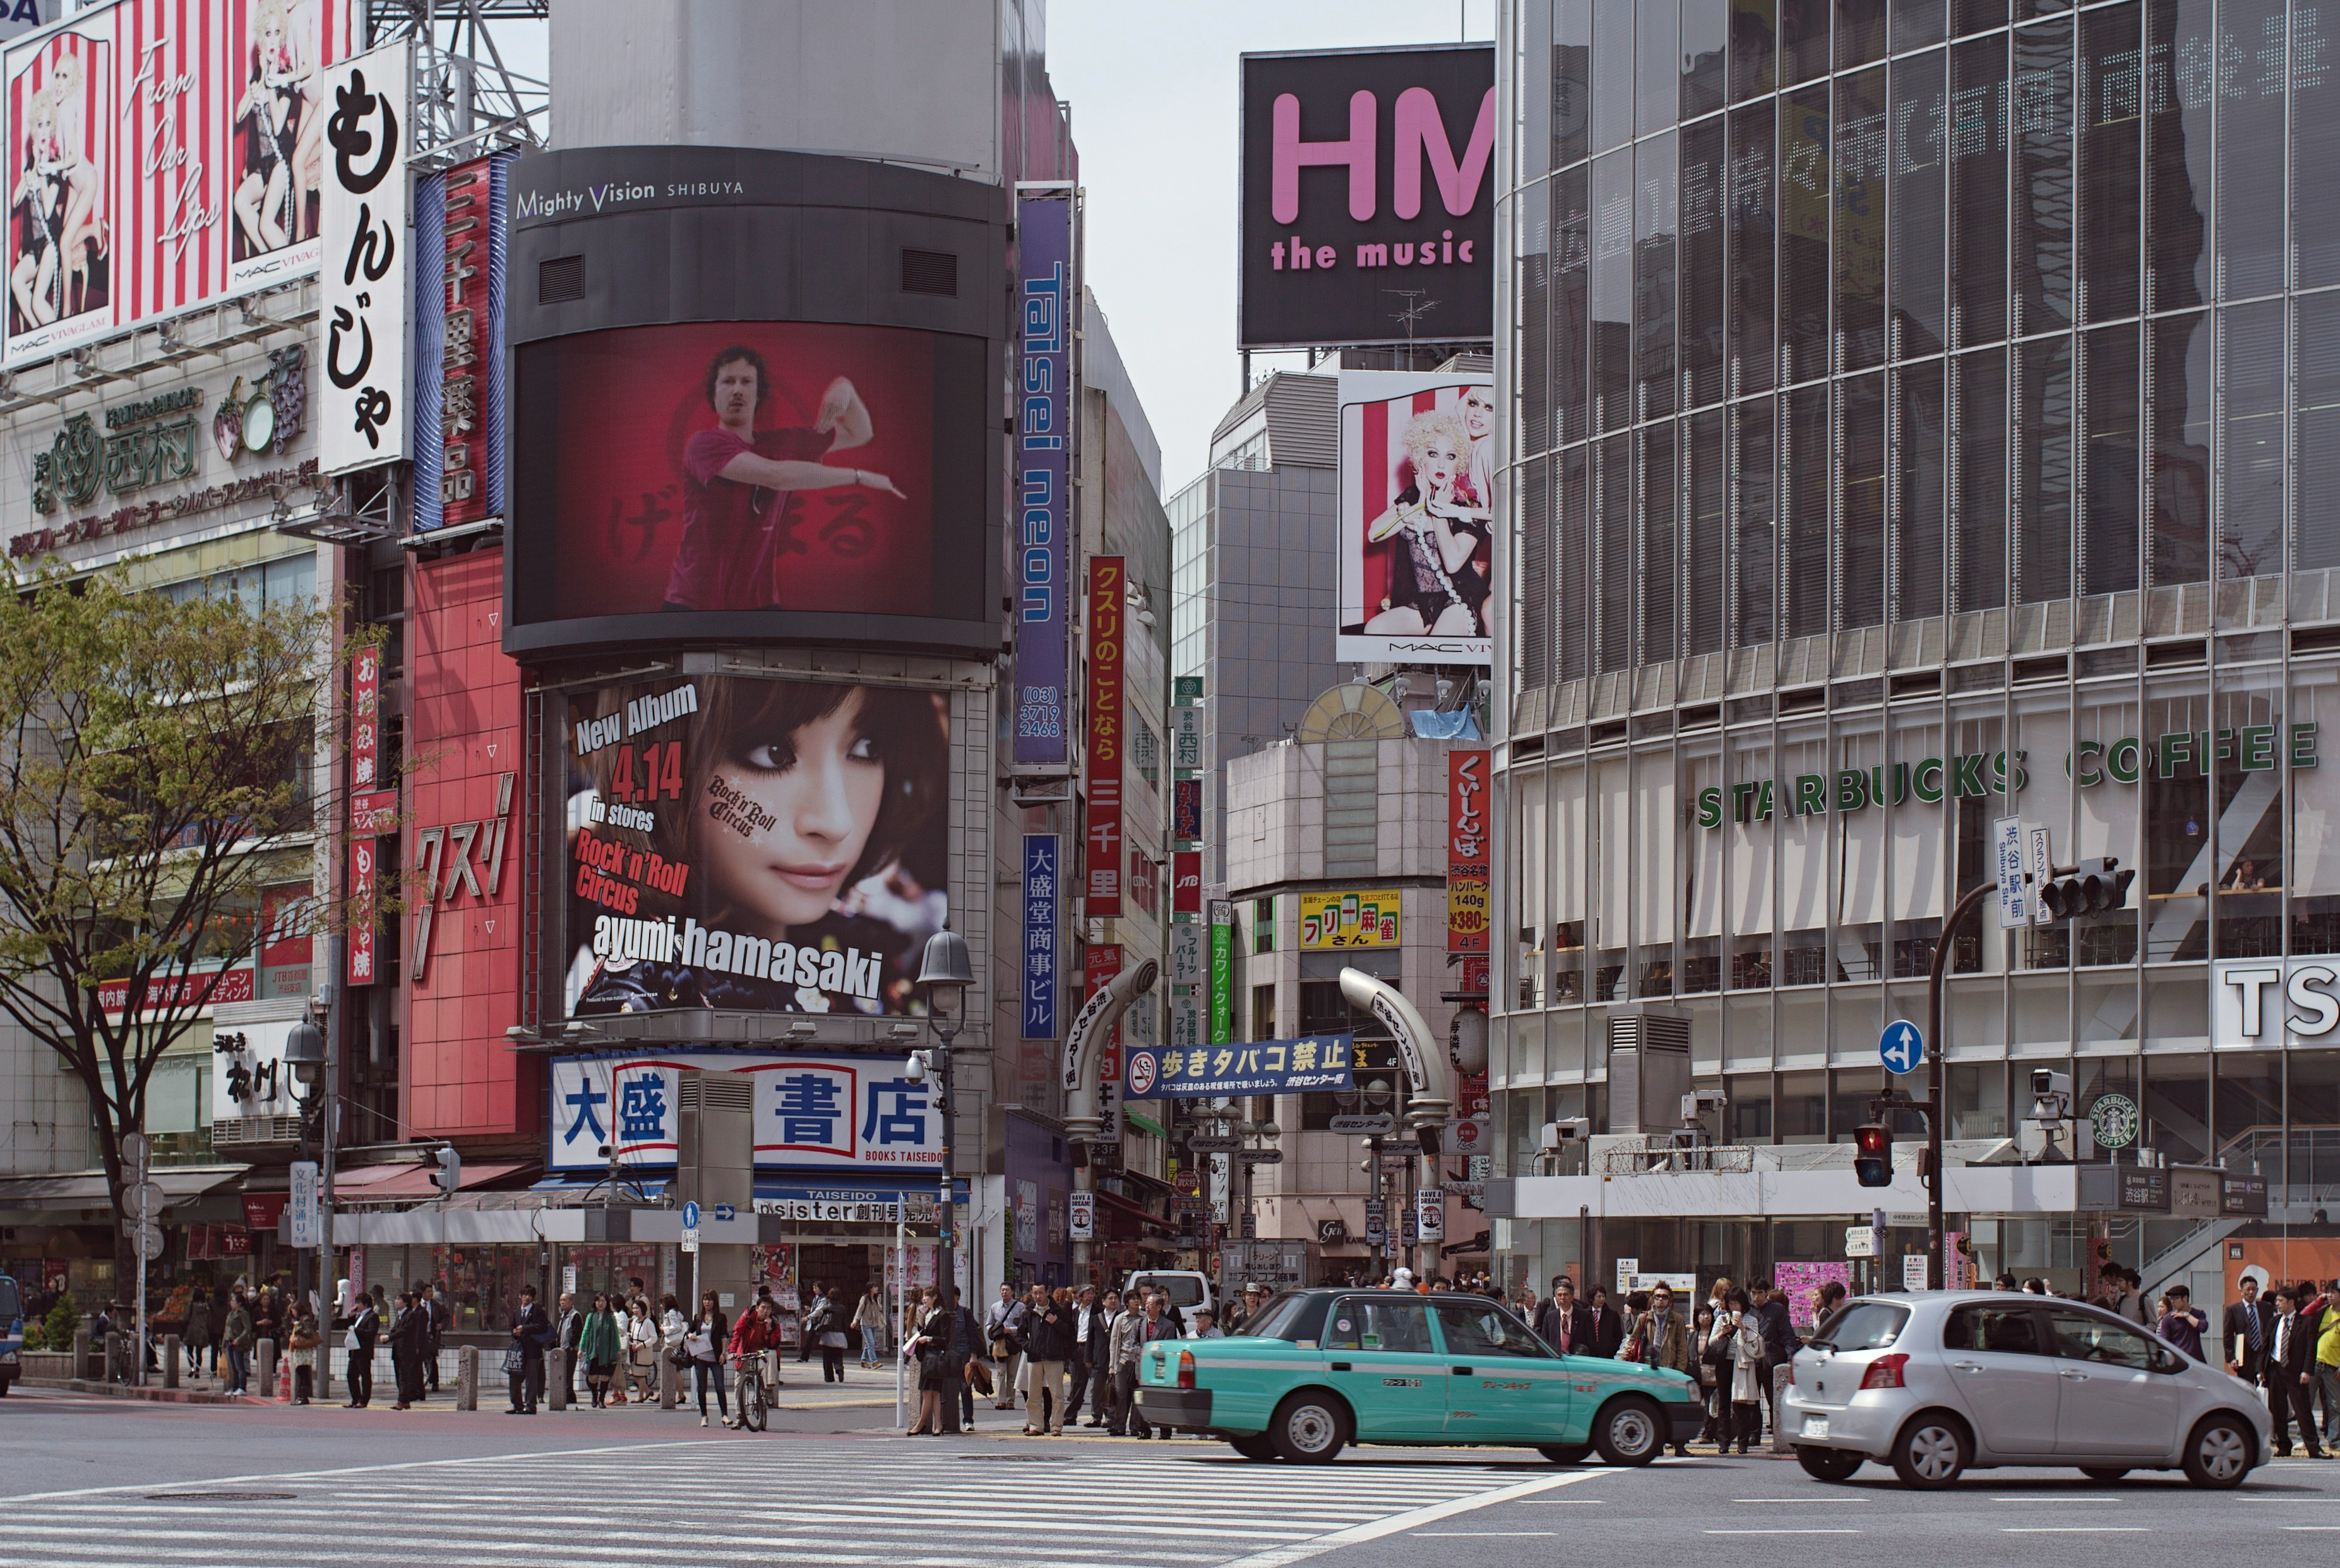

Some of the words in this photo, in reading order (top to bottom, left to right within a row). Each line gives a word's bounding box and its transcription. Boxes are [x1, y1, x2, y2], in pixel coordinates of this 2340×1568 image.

[123, 37, 195, 119] From
[143, 112, 188, 179] Our
[157, 162, 221, 263] Lips
[516, 189, 583, 218] Mighty
[589, 182, 654, 212] Vision
[668, 181, 744, 197] SHIBUYA
[327, 69, 399, 449] もんじゃ
[1271, 236, 1336, 270] the
[1357, 230, 1473, 268] music
[1023, 261, 1062, 451] Taisei
[105, 413, 198, 495] 西村
[1023, 468, 1052, 623] neon
[1094, 567, 1118, 761] クスリのことなら
[1020, 705, 1060, 721] 3719
[1023, 687, 1057, 704] (03)
[576, 711, 621, 756] New
[628, 682, 698, 738] Album
[1019, 722, 1060, 737] 2468
[1179, 733, 1198, 764] 西村
[611, 740, 683, 803] 4.14
[1697, 749, 2028, 829] STARBUCKS
[2065, 721, 2319, 788] COFFEE
[590, 796, 606, 822] in
[608, 804, 654, 833] stores
[1454, 756, 1484, 858] くいしんぼ
[1089, 780, 1120, 898] 三千里
[410, 772, 516, 981] クスリ
[575, 828, 689, 898] Rock'n'Roll
[1452, 864, 1488, 877] 渋谷名物
[1998, 842, 2007, 884] Shibuya
[2006, 826, 2023, 918] 渋谷駅前
[575, 863, 639, 915] Circus
[1450, 881, 1488, 892] ハンバーグ
[1455, 895, 1484, 908] 140g
[1028, 849, 1053, 1025] 大盛堂商事ビル
[1304, 908, 1394, 943] フリー麻雀
[1332, 935, 1369, 946] さん
[1459, 936, 1480, 949] 4F
[593, 913, 676, 965] ayumi
[681, 917, 883, 1002] hamasaki
[1176, 945, 1185, 980] パーラー
[1188, 937, 1197, 973] フルーツ
[97, 988, 126, 1008] 国内旅
[1066, 991, 1106, 1086] 渋谷センター街
[1376, 1000, 1420, 1086] 渋谷センター街
[1161, 1040, 1347, 1078] 歩きタバコ禁止
[1387, 1057, 1397, 1067] 4F
[1161, 1078, 1278, 1092] タバコは灰皿のある喫煙場所で吸いましょう。
[1285, 1073, 1345, 1087] 渋谷センター街
[564, 1072, 928, 1146] 大盛書店
[2091, 1096, 2136, 1121] STARBUCKS
[866, 1150, 897, 1161] BOOKS
[900, 1151, 942, 1163] TAISEIDO
[2096, 1132, 2131, 1145] COFFEE
[295, 1169, 306, 1234] 文化村通り
[807, 1191, 877, 1201] TAISEIDO
[1178, 1179, 1196, 1187] 消火栓
[2125, 1187, 2148, 1203] 渋谷駅
[1073, 1216, 1090, 1225] 京都
[1422, 1215, 1441, 1223] 浜松
